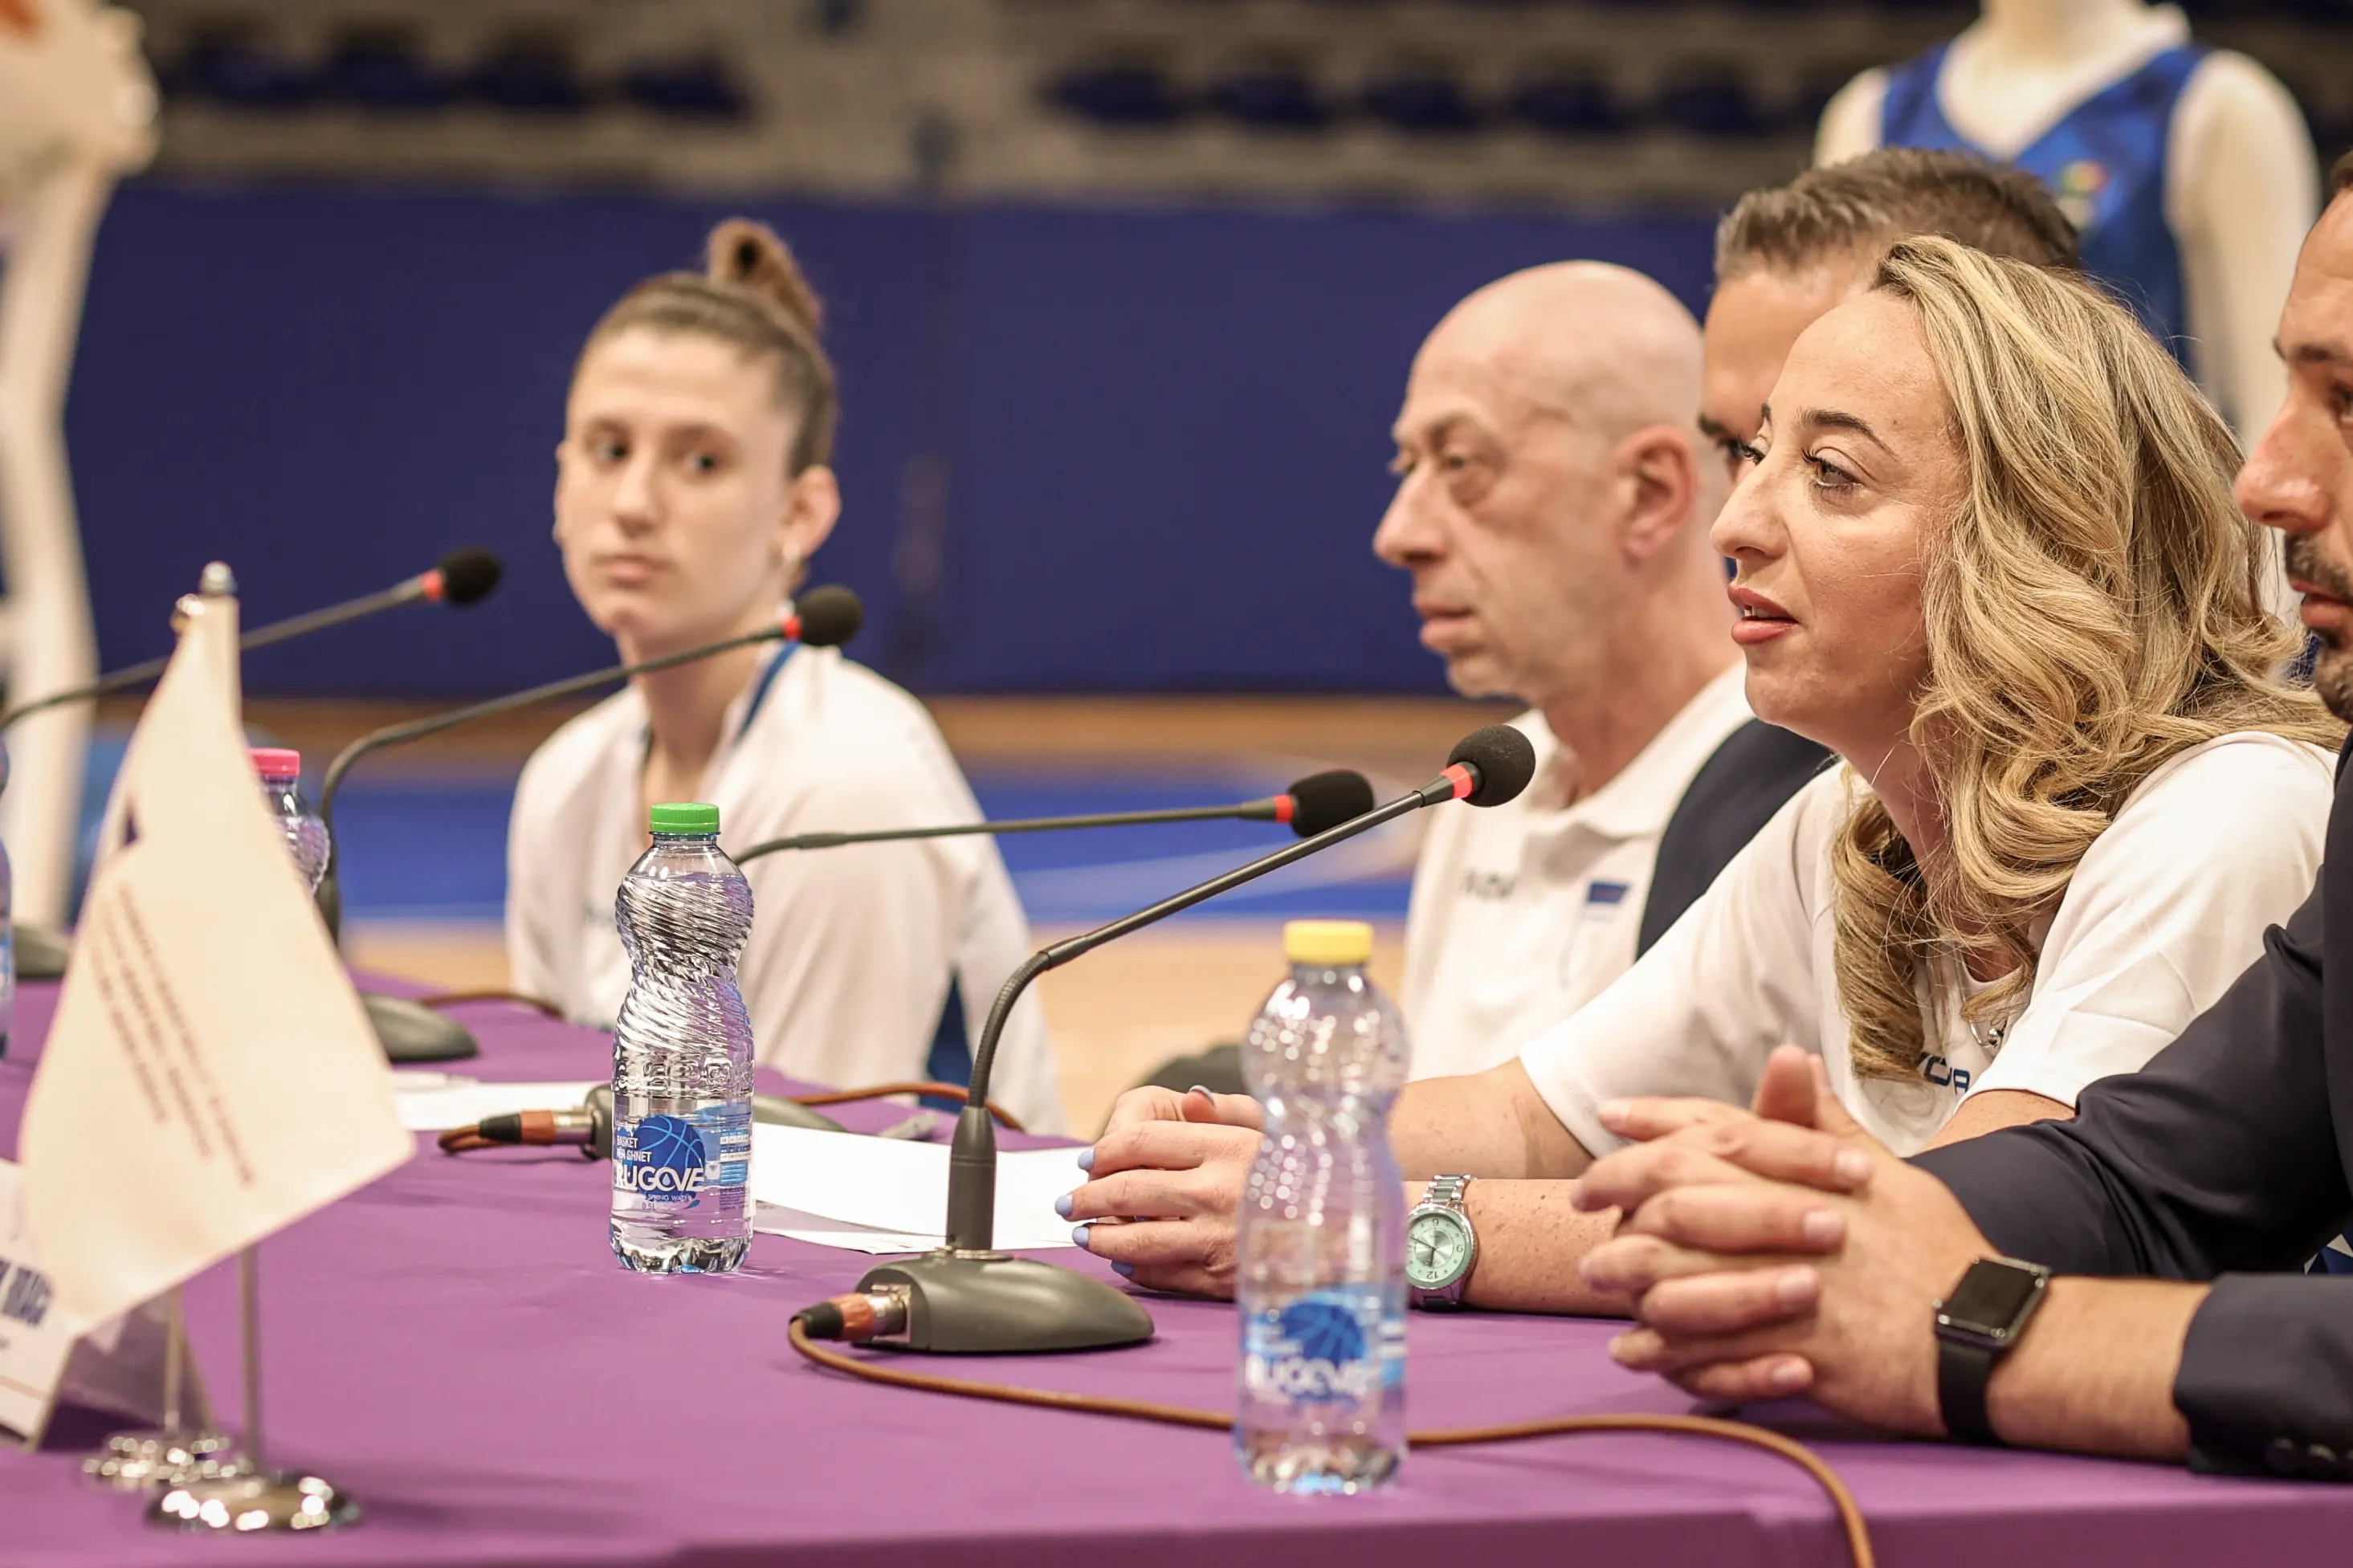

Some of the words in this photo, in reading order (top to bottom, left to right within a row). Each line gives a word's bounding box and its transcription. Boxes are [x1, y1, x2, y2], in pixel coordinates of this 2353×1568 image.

[616, 1134, 638, 1149] BASKET
[626, 1151, 652, 1163] SHNET
[616, 1164, 705, 1191] RUGOVE
